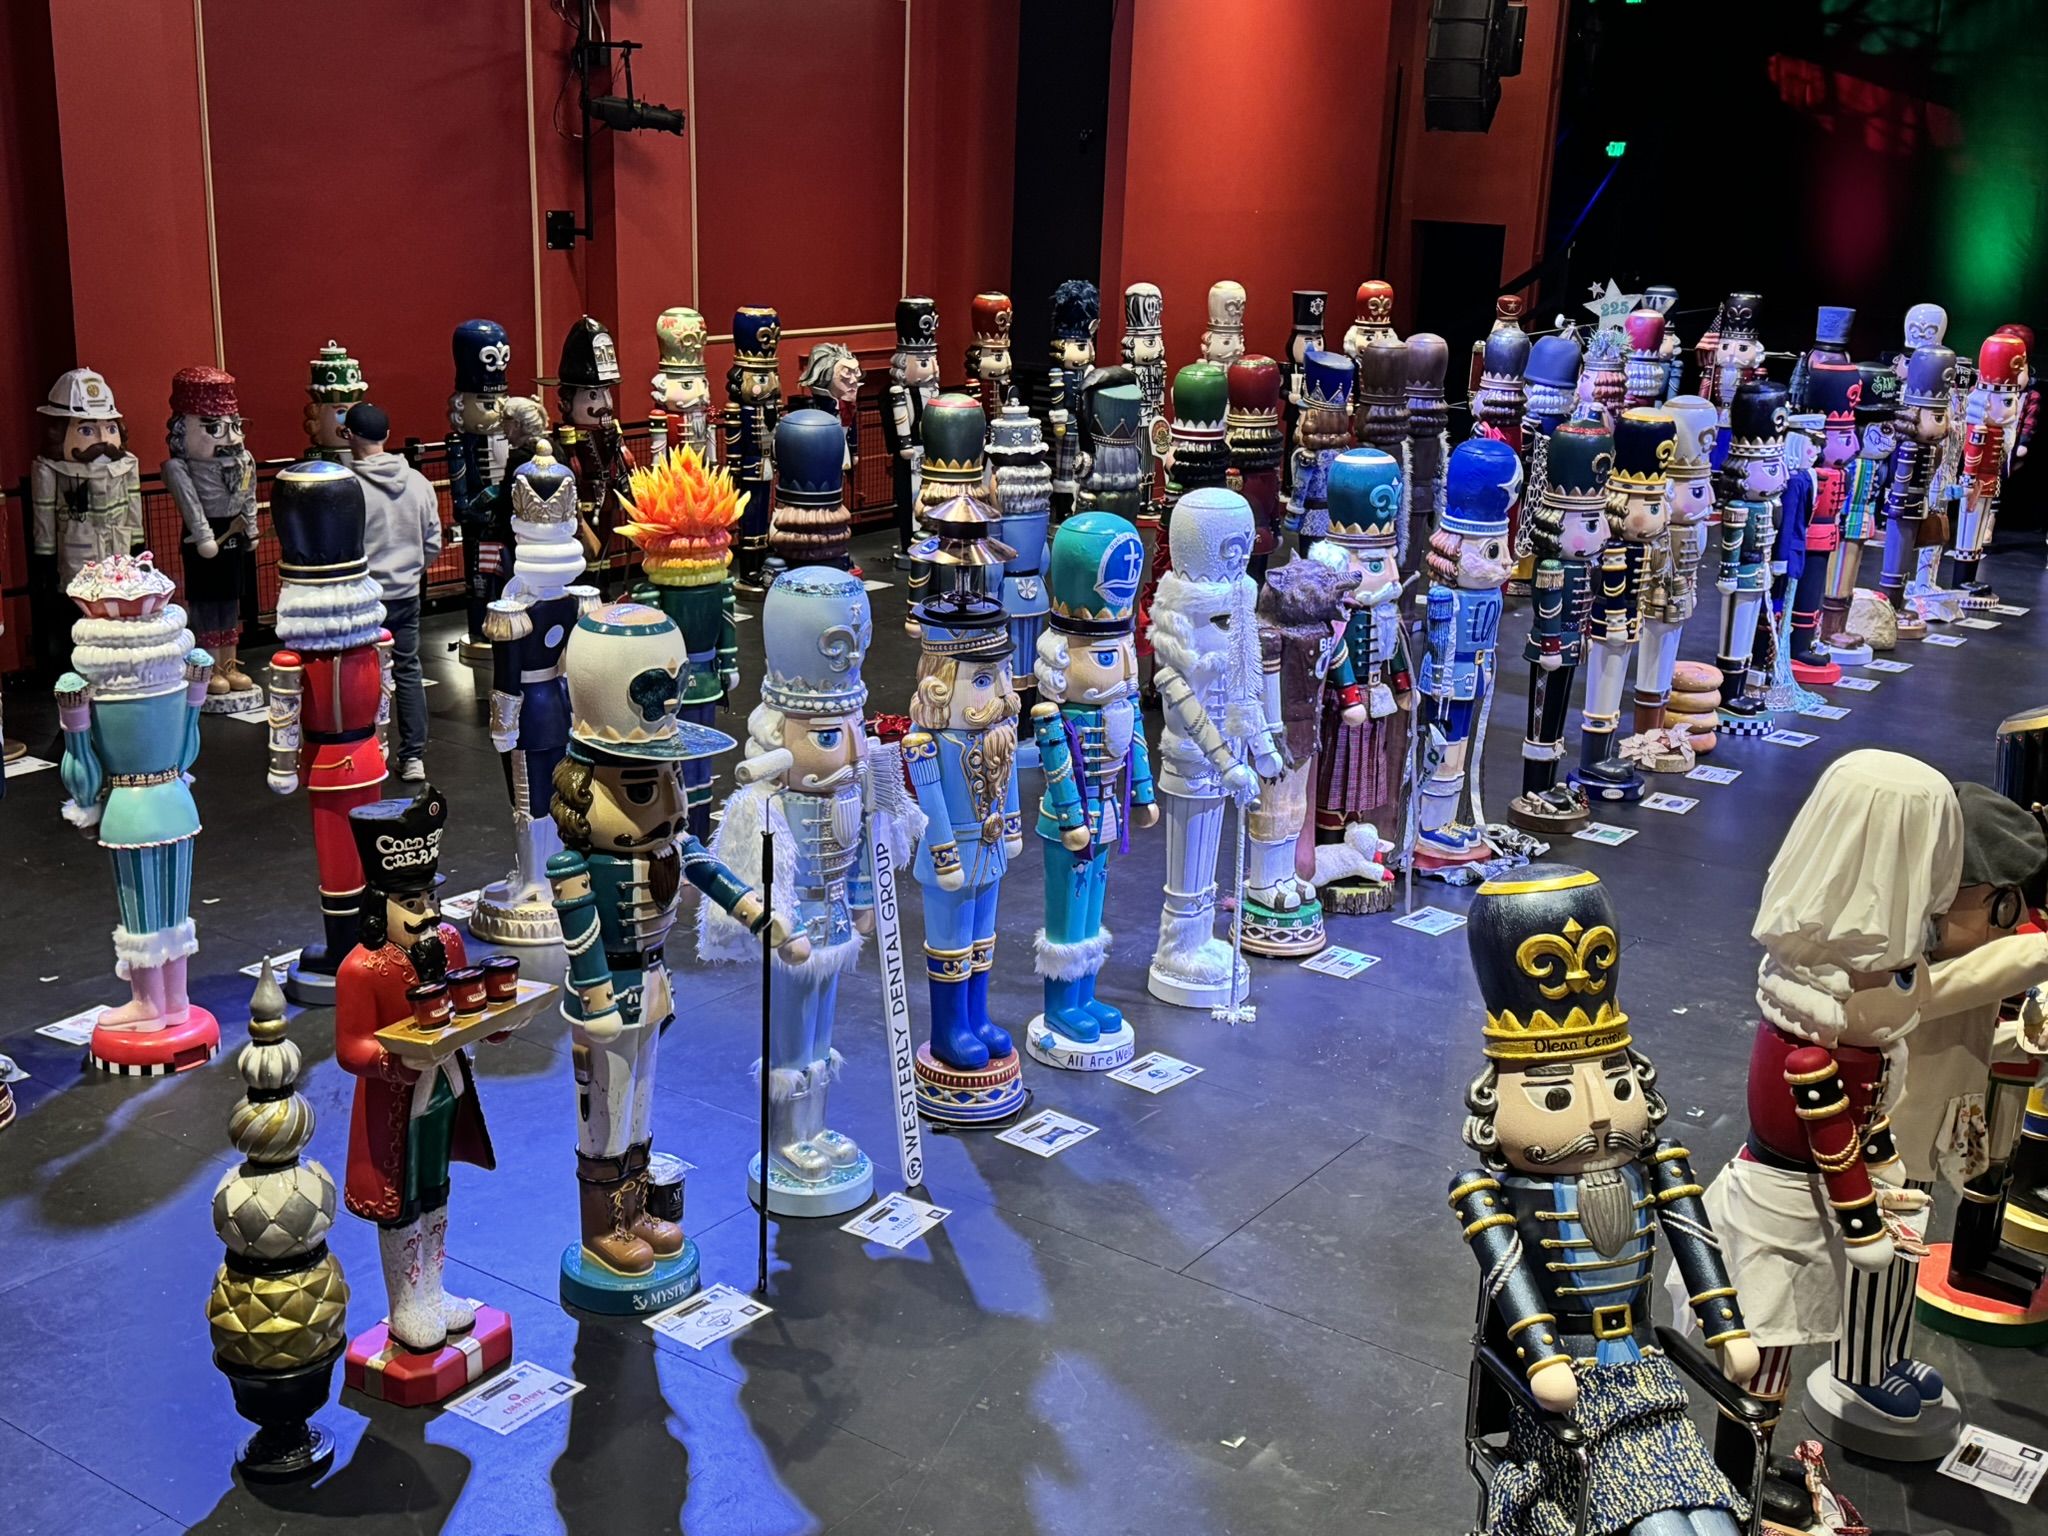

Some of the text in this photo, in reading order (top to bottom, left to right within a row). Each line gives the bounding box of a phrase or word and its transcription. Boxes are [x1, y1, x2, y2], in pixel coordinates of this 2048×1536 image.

[1601, 301, 1629, 317] 225
[876, 842, 896, 921] GROUP
[1266, 918, 1278, 928] 30
[1292, 920, 1302, 928] 40
[885, 924, 905, 1017] DENTAL
[1534, 1033, 1621, 1053] Olean Center
[1067, 1054, 1084, 1067] All
[1089, 1055, 1113, 1067] Are
[894, 1028, 919, 1157] WESTERLY
[651, 1280, 688, 1306] MYSTIC
